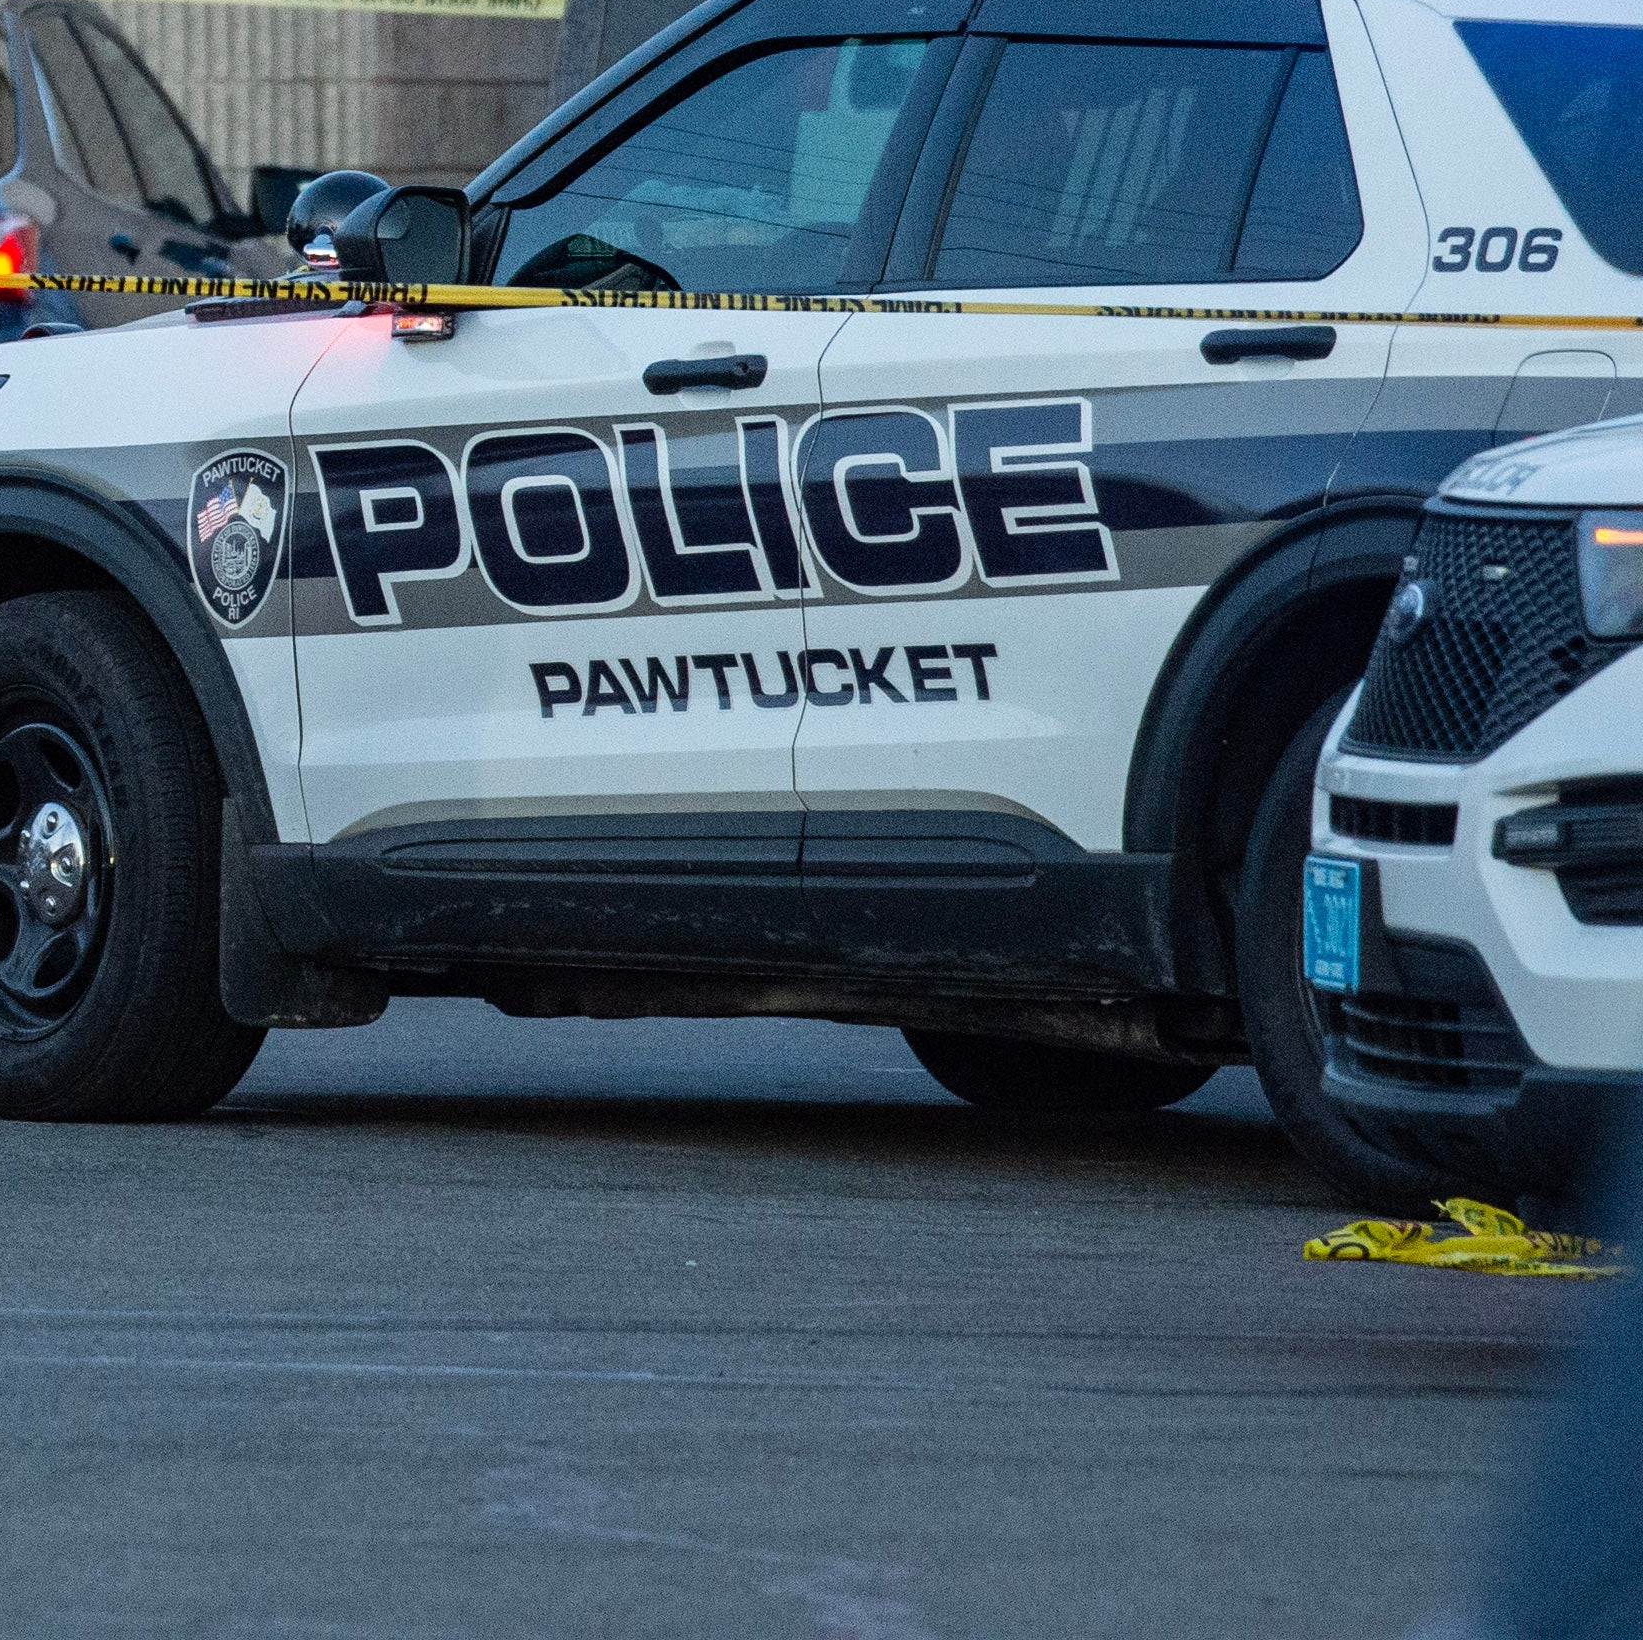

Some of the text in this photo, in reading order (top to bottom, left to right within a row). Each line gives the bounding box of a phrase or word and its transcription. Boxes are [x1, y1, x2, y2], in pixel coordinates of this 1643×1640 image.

[1432, 226, 1563, 273] 306
[202, 456, 281, 488] PAWTUCKET
[308, 397, 1121, 627] POLICE
[213, 585, 258, 608] POLICE
[228, 608, 240, 620] RI
[529, 641, 998, 720] PAWTUCKET
